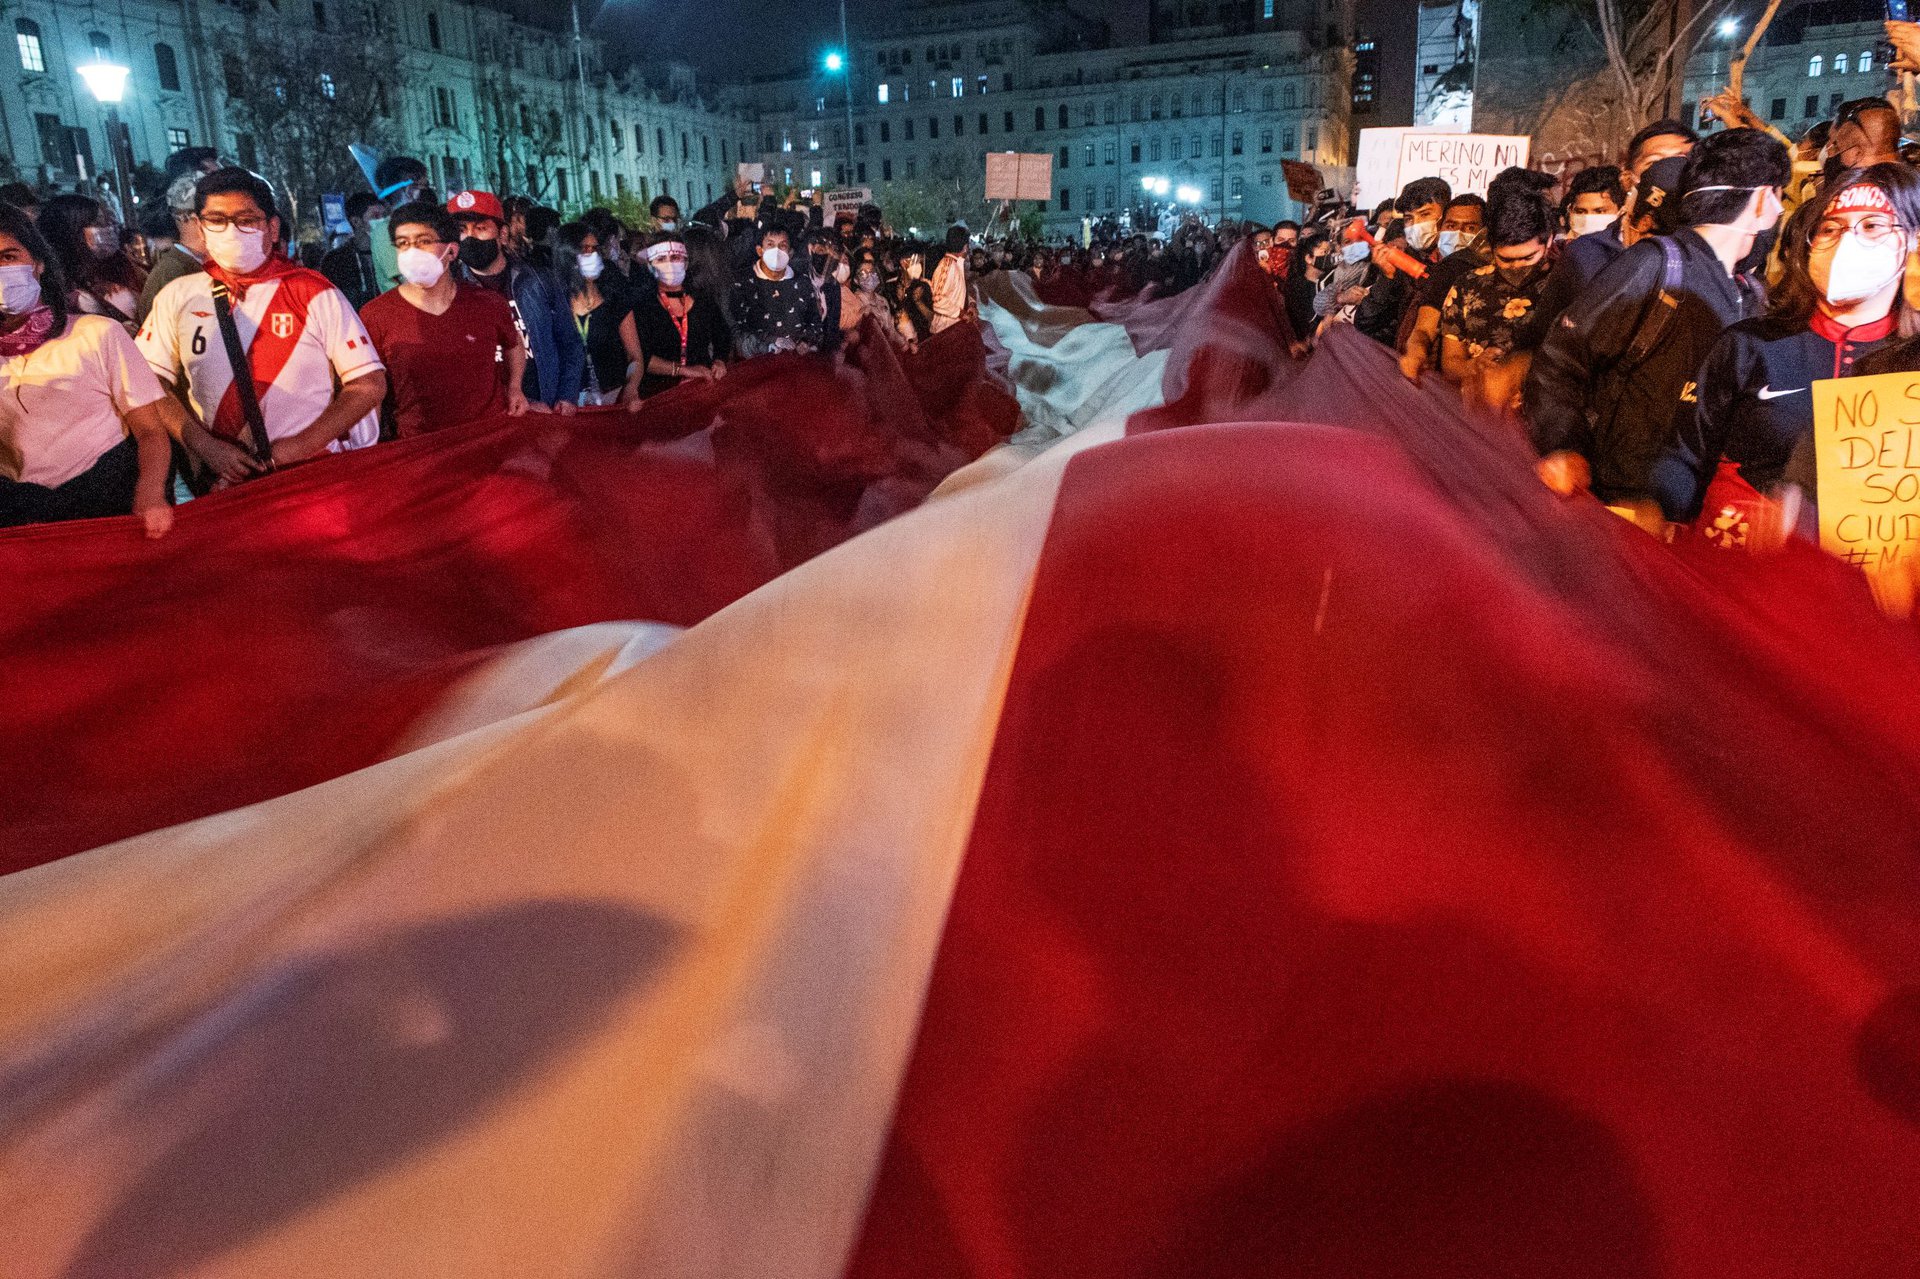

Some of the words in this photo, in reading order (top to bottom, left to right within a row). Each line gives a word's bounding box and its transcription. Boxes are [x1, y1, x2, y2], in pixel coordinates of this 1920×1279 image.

[1408, 140, 1485, 166] MERINO
[1494, 144, 1519, 167] NO
[1467, 168, 1488, 189] MI
[1836, 186, 1887, 210] SOMOS
[191, 325, 207, 355] 6
[1834, 389, 1878, 432] NO
[1839, 427, 1920, 470] DEL
[1860, 473, 1920, 504] SO
